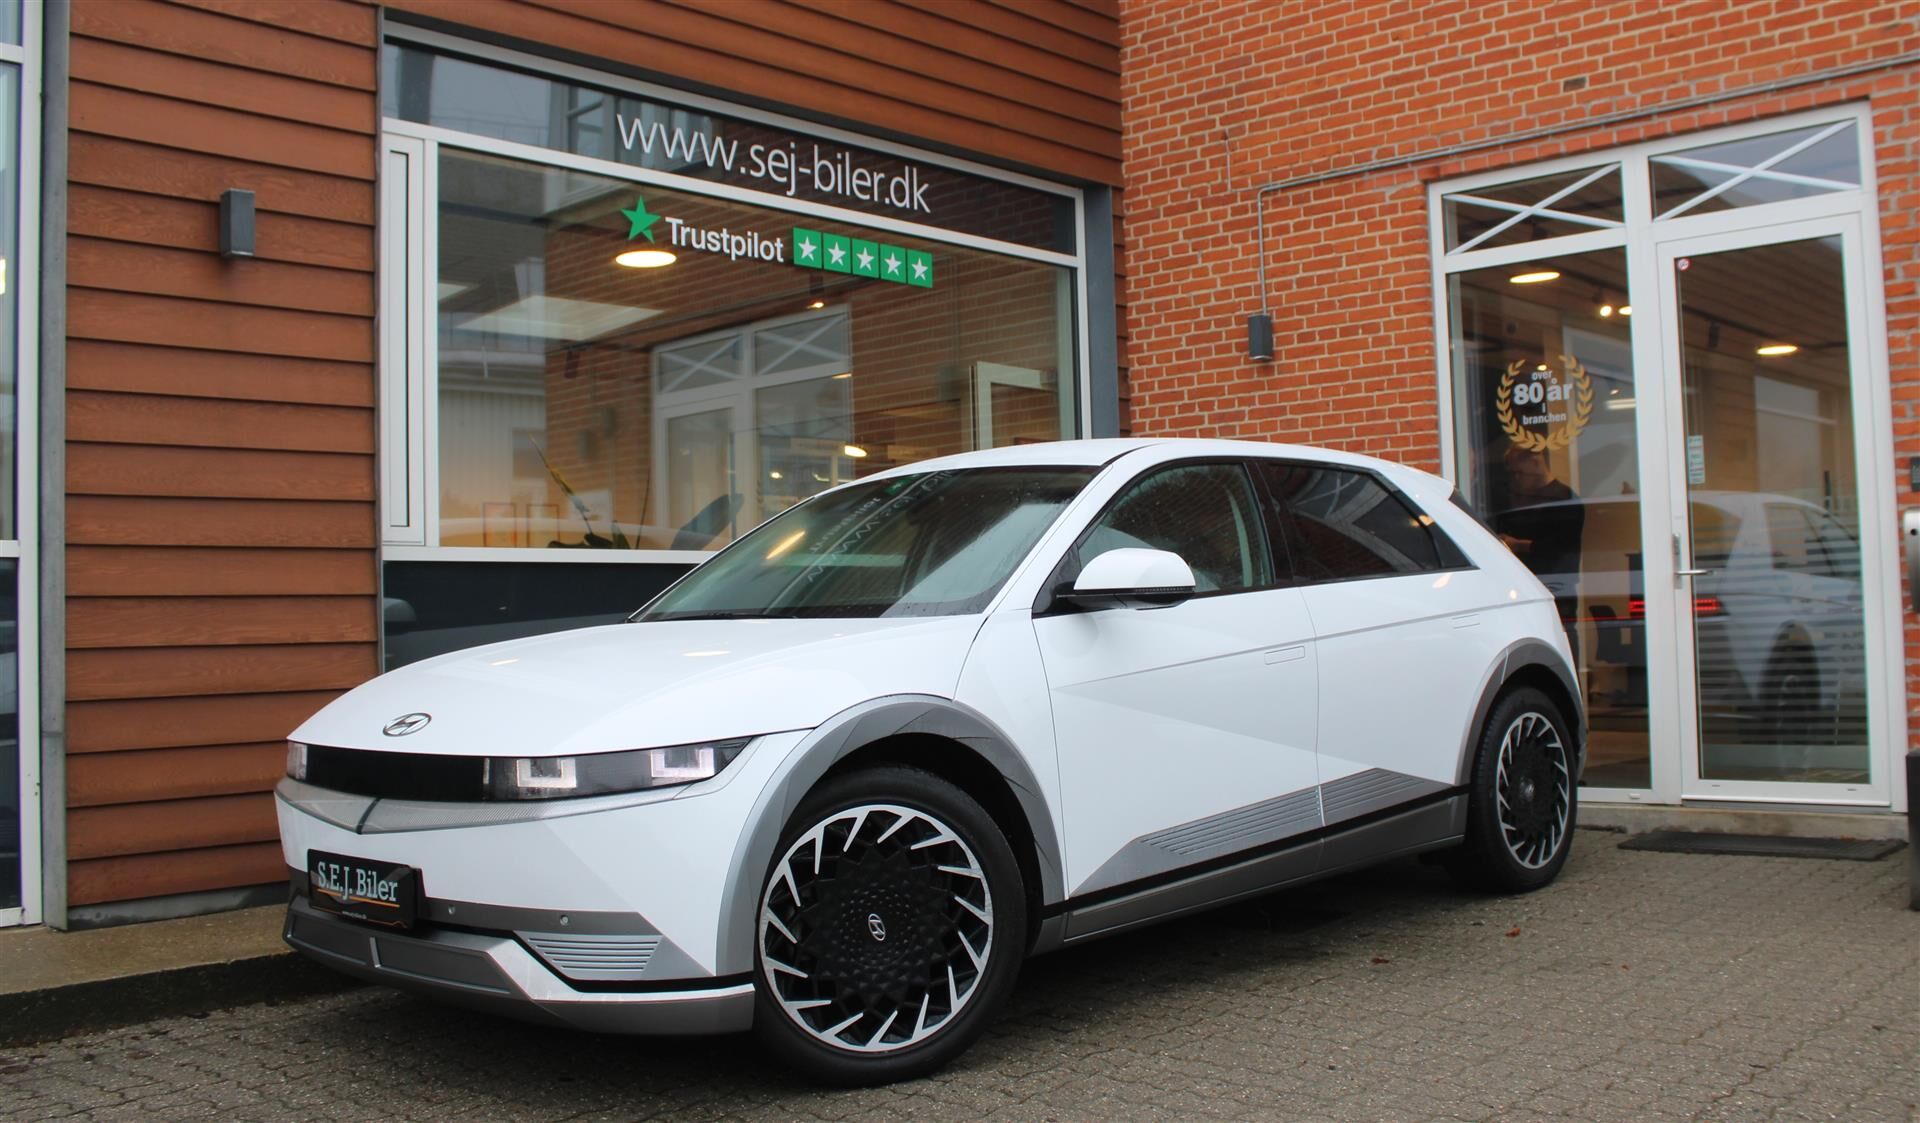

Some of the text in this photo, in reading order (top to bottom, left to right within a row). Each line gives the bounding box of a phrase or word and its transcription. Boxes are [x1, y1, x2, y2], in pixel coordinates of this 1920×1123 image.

[616, 113, 931, 213] www.sej-biler.dk
[665, 216, 785, 263] Trustpilot
[1513, 378, 1573, 405] 80 år
[1531, 371, 1552, 380] over
[1522, 413, 1567, 425] branchen
[317, 861, 398, 902] S.E.J. Biler
